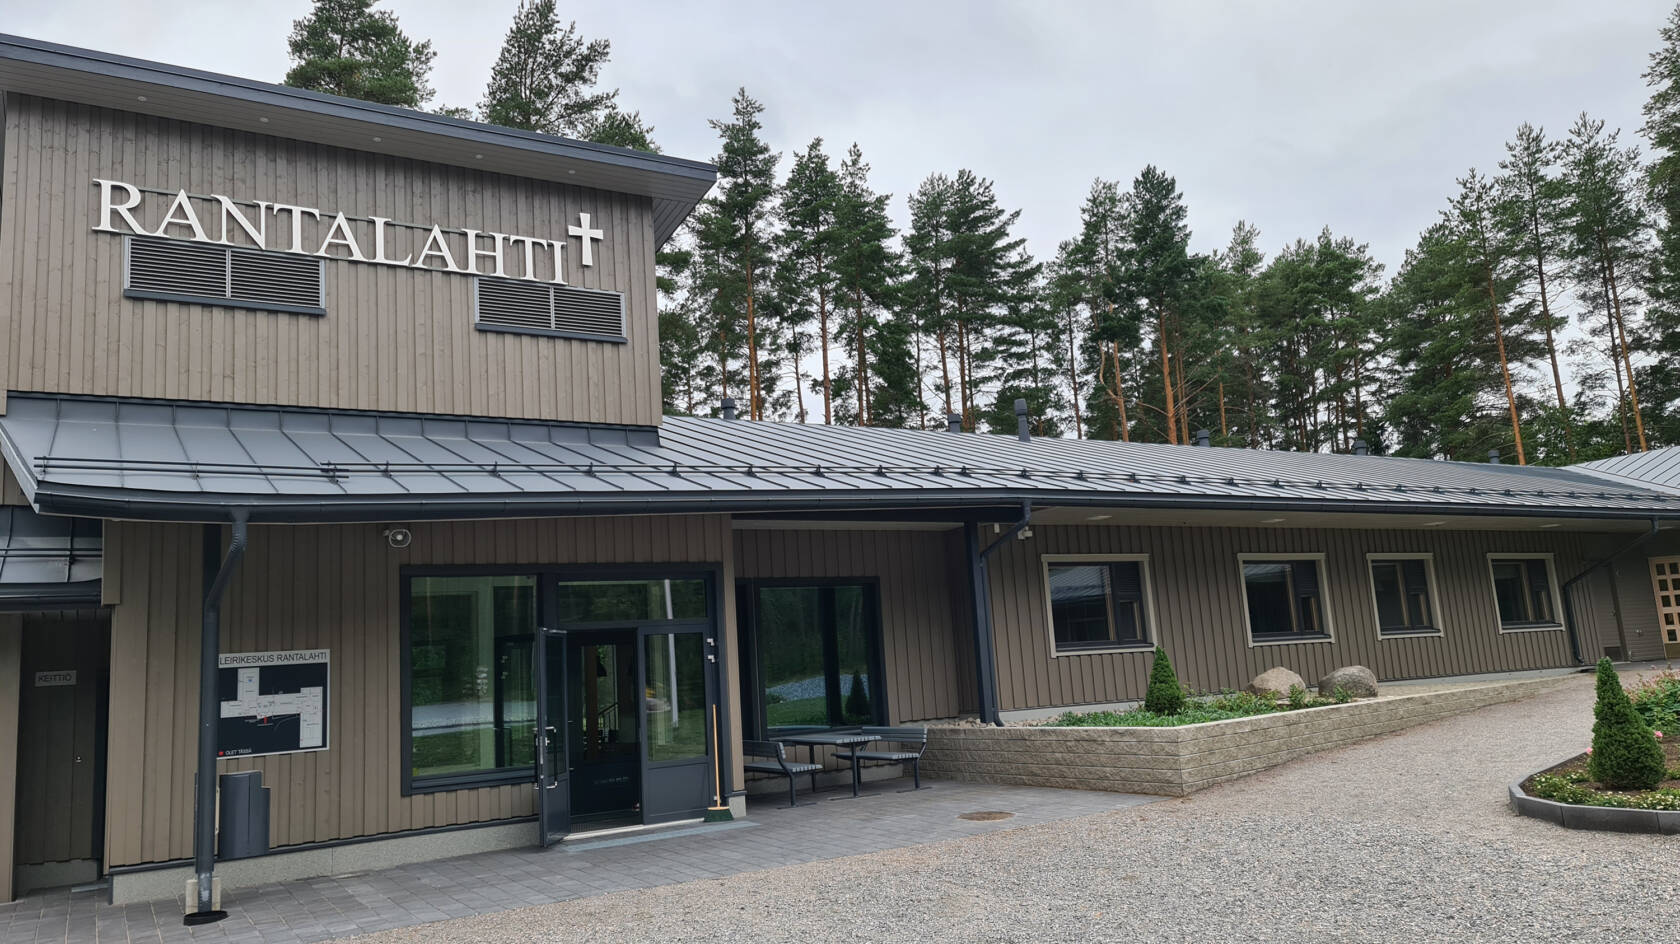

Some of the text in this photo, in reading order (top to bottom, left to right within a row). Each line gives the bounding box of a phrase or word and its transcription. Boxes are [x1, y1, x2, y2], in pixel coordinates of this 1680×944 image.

[92, 178, 568, 285] RANTALAHTI
[219, 651, 327, 665] LEIRIKESKUS RANTALAHTI
